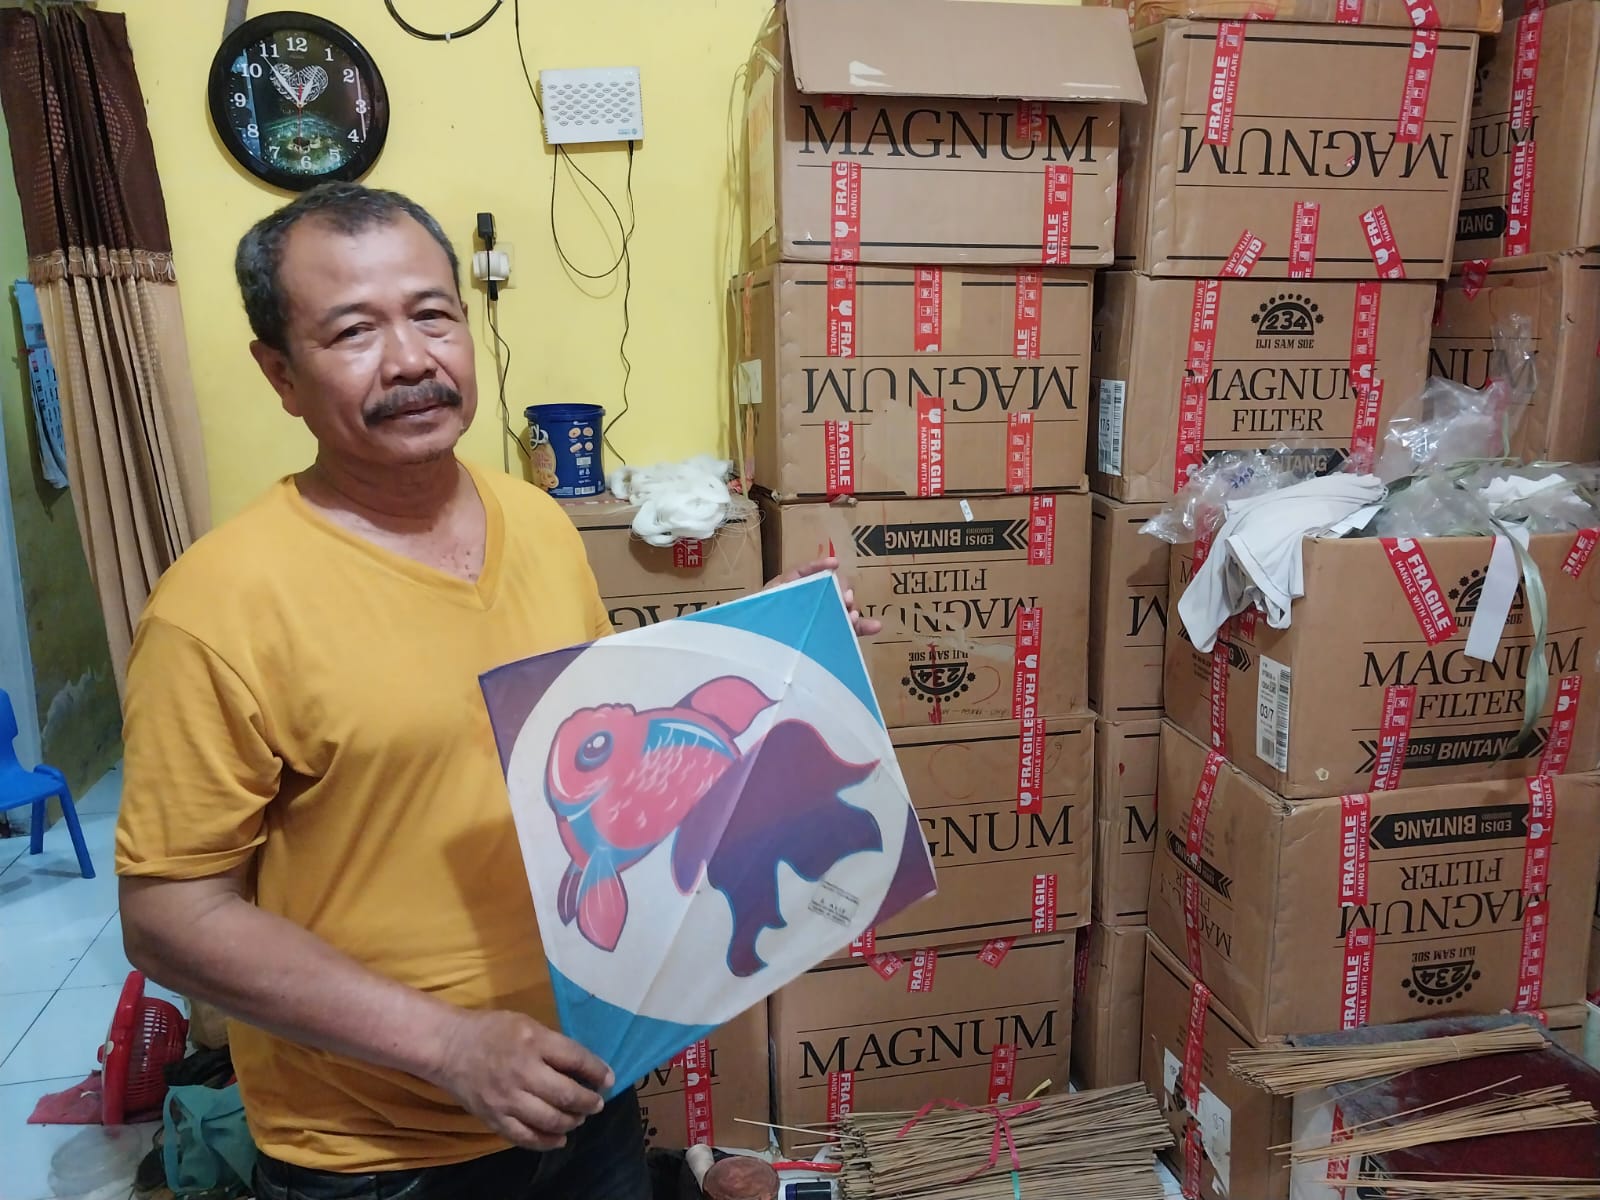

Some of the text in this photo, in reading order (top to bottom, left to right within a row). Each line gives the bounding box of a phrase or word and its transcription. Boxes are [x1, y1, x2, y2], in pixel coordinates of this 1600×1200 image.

[260, 43, 280, 57] 11
[286, 37, 308, 52] 12
[325, 48, 334, 61] 1
[241, 63, 262, 78] 10
[343, 69, 355, 83] 2
[233, 92, 247, 107] 9
[355, 100, 367, 114] 3
[1208, 56, 1228, 140] FRAGILE
[1222, 53, 1239, 143] HANDLE WITH CARE
[247, 124, 260, 138] 8
[348, 129, 359, 143] 4
[799, 104, 1098, 163] MAGNUM
[269, 146, 280, 160] 7
[300, 156, 312, 169] 6
[329, 149, 340, 162] 5
[1177, 126, 1453, 179] MAGNUM
[1526, 157, 1534, 180] WITH
[851, 182, 859, 218] HANDLE
[1523, 181, 1531, 216] HANDLE
[1377, 209, 1391, 242] HANDLE
[1193, 287, 1204, 333] WITH CARE
[1267, 311, 1307, 331] 234
[830, 319, 838, 354] HANDLE
[1274, 338, 1294, 350] SAM
[1297, 338, 1315, 350] SOE
[802, 366, 1079, 413] MAGNUM
[1231, 408, 1324, 433] FILTER
[920, 426, 928, 459] HANDLE
[886, 528, 961, 549] BINTANG
[965, 534, 994, 546] EDISI
[890, 568, 988, 595] FILTER
[1408, 553, 1452, 631] FRAGILE
[1395, 560, 1437, 640] HANDLE WITH CARE
[908, 652, 926, 662] SOE
[917, 666, 962, 688] 234
[1015, 671, 1023, 704] HANDLE
[1213, 651, 1223, 729] FRAGILE
[1260, 703, 1275, 720] 03/7
[1415, 688, 1527, 720] FILTER
[1391, 756, 1401, 777] WITH
[1396, 731, 1407, 754] CARE
[1394, 814, 1512, 841] EDISI BINTANG
[1342, 815, 1357, 897] FRAGILE
[1358, 862, 1366, 897] HANDLE
[1400, 857, 1504, 891] FILTER
[1412, 951, 1430, 962] SOE
[1433, 948, 1456, 960] SAM
[1360, 950, 1371, 996] WITH CARE
[1421, 967, 1467, 988] 234
[1344, 954, 1360, 1030] FRAGILE
[799, 1010, 1059, 1079] MAGNUM
[830, 1072, 838, 1101] HANDLE
